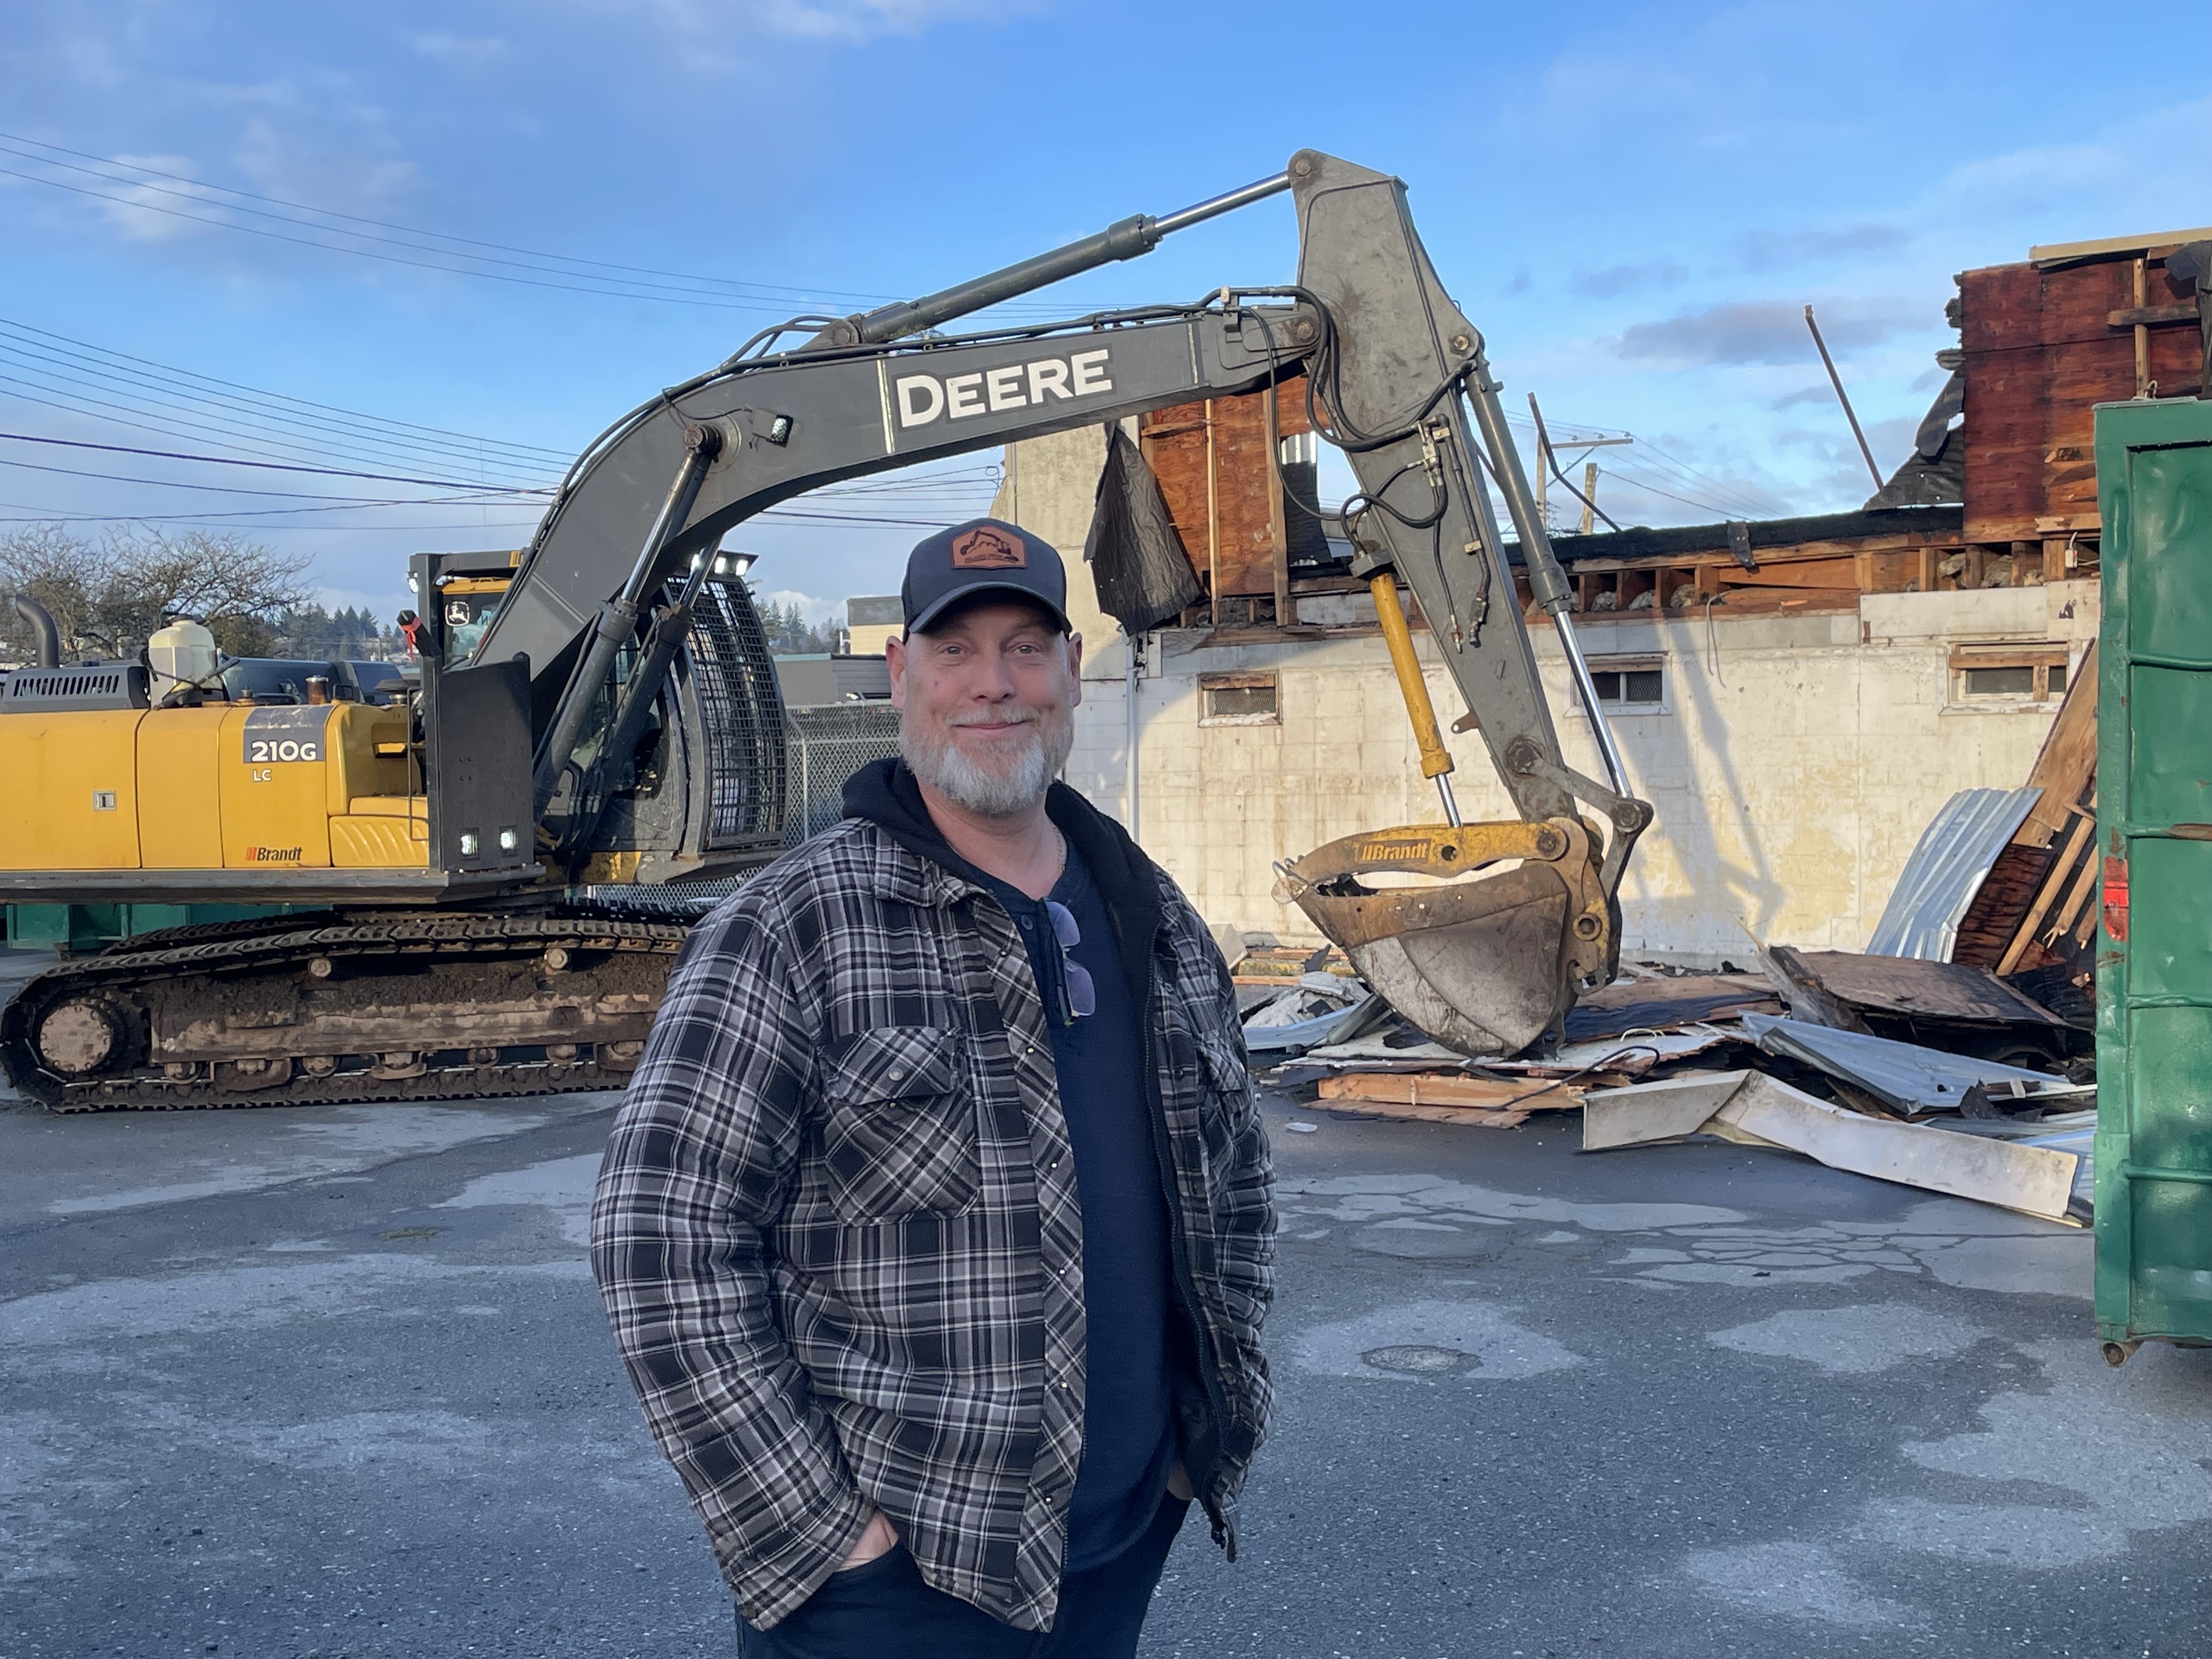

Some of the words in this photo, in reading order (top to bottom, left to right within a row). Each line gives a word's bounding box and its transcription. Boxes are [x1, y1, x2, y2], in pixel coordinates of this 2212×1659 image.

[896, 348, 1113, 428] DEERE
[252, 740, 317, 761] 210G
[253, 769, 272, 782] LC
[257, 847, 302, 861] Brandt
[1372, 842, 1427, 860] Brandt
